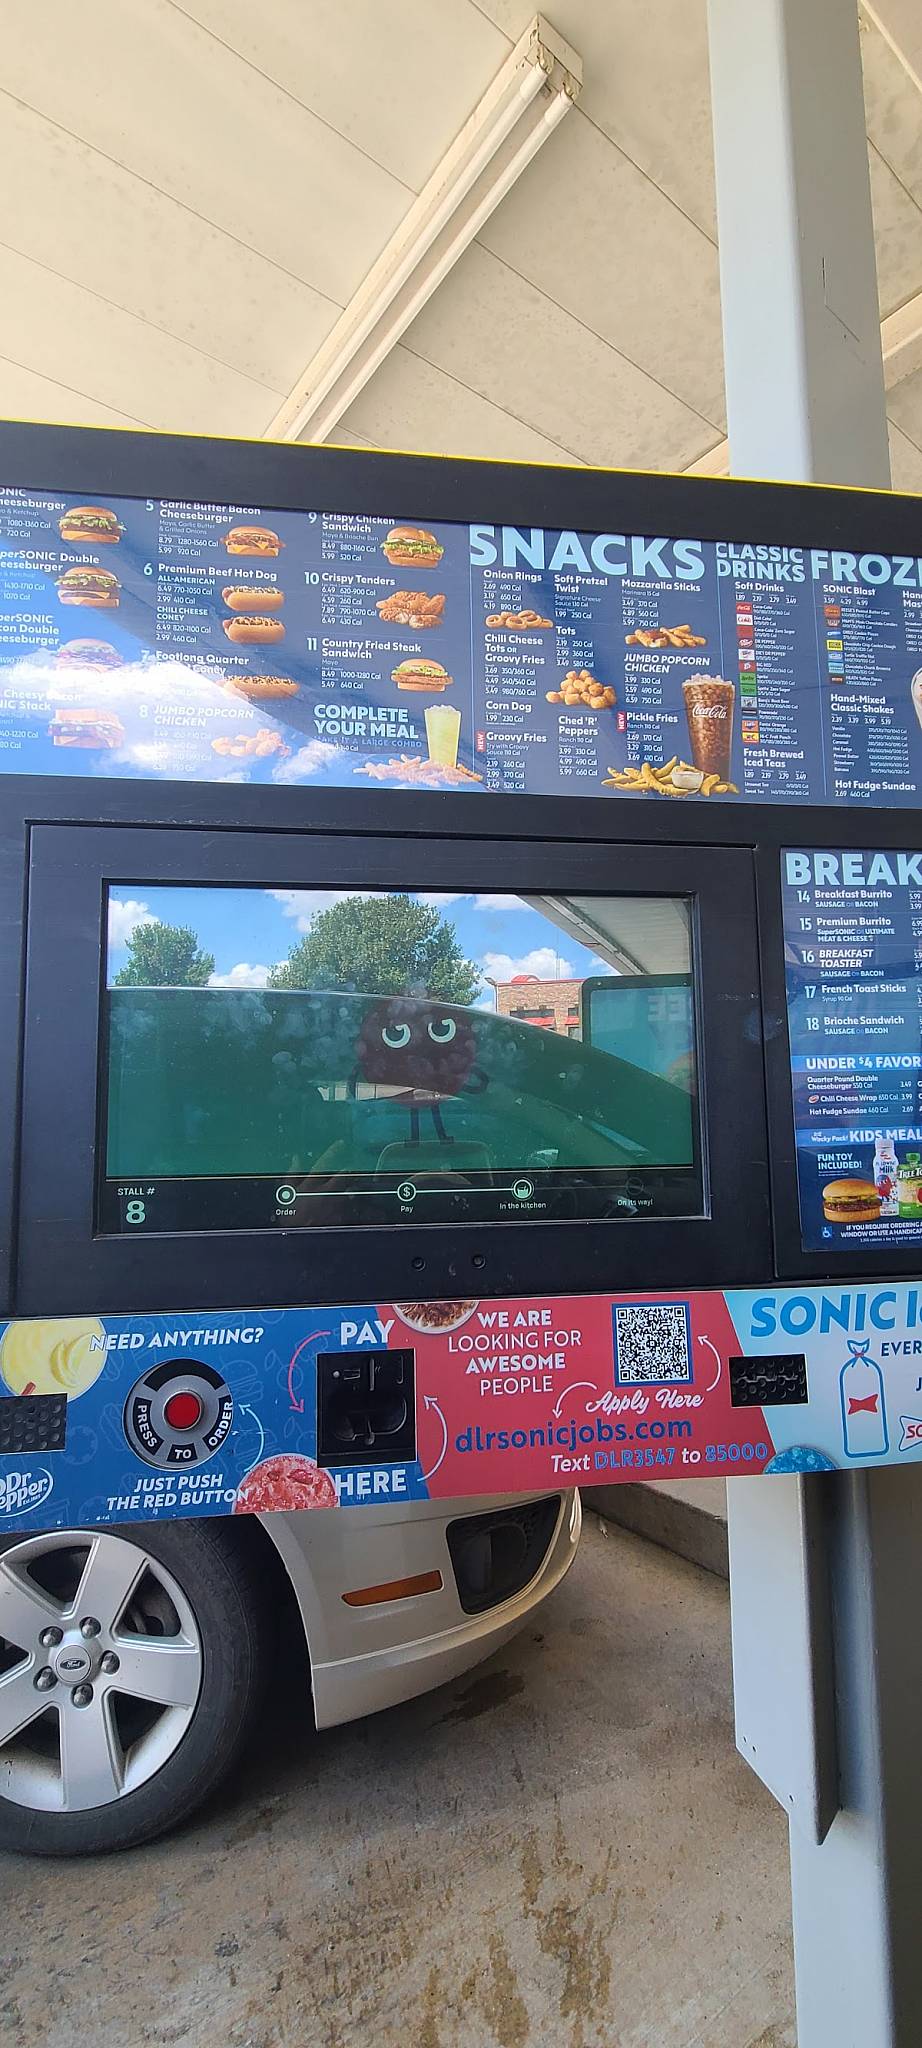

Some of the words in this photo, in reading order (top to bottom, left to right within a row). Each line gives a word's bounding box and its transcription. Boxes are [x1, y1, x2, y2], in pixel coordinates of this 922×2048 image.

[146, 500, 153, 511] 5
[160, 501, 191, 509] Garlic
[194, 503, 226, 512] Butter
[229, 505, 260, 514] Bacon
[160, 510, 233, 523] Cheeseburger
[309, 513, 317, 523] 9
[323, 514, 354, 524] Crispy
[356, 515, 394, 524] Chicken
[322, 522, 371, 532] Sandwich
[60, 553, 99, 563] Double
[470, 524, 705, 580] SNACKS
[716, 542, 803, 563] CLASSIC
[144, 563, 152, 575] 6
[159, 563, 206, 574] Premium
[209, 567, 232, 576] Beef
[235, 569, 253, 578] Hot
[256, 570, 277, 582] Dog
[717, 559, 805, 582] DRINKS
[811, 549, 922, 587] FROZ
[158, 576, 215, 585] ALL-AMERICAN
[305, 572, 319, 584] 10
[322, 573, 353, 584] Crispy
[357, 575, 395, 585] Tenders
[484, 570, 512, 580] Onion
[515, 571, 542, 583] Rings
[555, 575, 574, 583] Soft
[576, 576, 607, 586] Pretzel
[555, 584, 579, 593] Twist
[622, 579, 672, 590] Mozzarella
[674, 582, 701, 592] Sticks
[735, 582, 753, 590] Soft
[755, 583, 784, 592] Drinks
[823, 585, 852, 593] SONIC
[854, 587, 876, 595] Blast
[20, 625, 59, 634] Double
[557, 626, 576, 635] Tots
[307, 638, 317, 650] 11
[322, 638, 363, 649] Country
[366, 640, 390, 650] Fried
[393, 642, 421, 652] Steak
[485, 634, 506, 643] Chili
[509, 635, 543, 645] Cheese
[322, 648, 372, 659] Sandwich
[485, 644, 505, 652] Tots
[156, 651, 204, 664] Footlong
[207, 655, 249, 665] Quarter
[485, 654, 520, 665] Groovy
[523, 656, 545, 664] Fries
[624, 654, 659, 663] JUMBO
[661, 656, 710, 665] POPCORN
[625, 664, 670, 673] CHICKEN
[4, 690, 44, 699] Cheesy
[831, 694, 885, 704] Hand-Mixed
[20, 702, 51, 710] Stack
[155, 706, 194, 715] JUMBO
[198, 708, 254, 718] POPCORN
[486, 701, 509, 709] Corn
[512, 702, 532, 712] Dog
[831, 704, 861, 712] Classic
[863, 705, 894, 714] Shakes
[314, 704, 408, 722] COMPLETE
[627, 712, 654, 722] Pickle
[656, 714, 678, 722] Fries
[155, 716, 206, 726] CHICKEN
[559, 716, 583, 725] Ched
[314, 720, 365, 736] YOUR
[371, 723, 418, 738] MEAL
[559, 726, 598, 736] Peppers
[487, 732, 522, 743] Groovy
[524, 733, 546, 742] Fries
[392, 740, 422, 748] COMBO
[744, 748, 768, 757] Fresh
[770, 750, 803, 759] Brewed
[765, 759, 786, 767] Teas
[835, 780, 851, 788] Hot
[854, 781, 881, 791] Fudge
[882, 782, 916, 790] Sundae
[786, 853, 922, 885] BREAK
[797, 891, 810, 903] 14
[815, 890, 859, 899] Breakfast
[861, 890, 892, 898] Burrito
[800, 918, 812, 930] 15
[817, 918, 857, 926] Premium
[860, 918, 891, 926] Burrito
[802, 951, 814, 962] 16
[819, 950, 873, 958] BREAKFAST
[805, 986, 816, 998] 17
[822, 985, 852, 993] French
[854, 985, 879, 993] Toast
[880, 985, 906, 993] Sticks
[806, 1018, 819, 1030] 18
[824, 1017, 858, 1025] Brioche
[860, 1016, 904, 1024] Sandwich
[806, 1058, 855, 1069] UNDER
[859, 1057, 873, 1068] $4
[876, 1056, 921, 1068] FAVOR
[860, 1095, 877, 1103] Wrap
[850, 1131, 882, 1142] KIDS
[886, 1129, 922, 1140] MEAL
[818, 1161, 862, 1170] INCLUDED!
[118, 1187, 144, 1196] STALL
[147, 1187, 155, 1195] #
[400, 1205, 413, 1213] Pay
[521, 1201, 546, 1209] kitchen
[126, 1200, 146, 1224] 8
[276, 1208, 296, 1216] Order
[477, 1312, 509, 1328] WE
[514, 1310, 551, 1327] ARE
[751, 1292, 896, 1337] SONIC
[340, 1320, 395, 1346] PAY
[90, 1334, 145, 1351] NEED
[150, 1328, 264, 1348] ANYTHING?
[448, 1334, 538, 1352] LOOKING
[544, 1330, 582, 1348] FOR
[466, 1353, 565, 1374] AWESOME
[480, 1376, 553, 1396] PEOPLE
[585, 1390, 649, 1415] Apply
[656, 1389, 704, 1409] Here
[136, 1404, 157, 1448] PRESS
[209, 1401, 232, 1446] ORDER
[455, 1418, 692, 1453] dlrsonicjobs.com
[175, 1449, 192, 1459] TO
[552, 1455, 590, 1472] Text
[594, 1448, 675, 1469] DLR3547
[682, 1448, 700, 1464] to
[706, 1443, 768, 1461] 85000
[6, 1472, 32, 1493] Dr
[134, 1477, 175, 1492] JUST
[179, 1475, 223, 1489] PUSH
[334, 1470, 407, 1497] HERE
[107, 1497, 141, 1510] THE
[144, 1493, 177, 1508] RED
[180, 1489, 249, 1505] BUTTON
